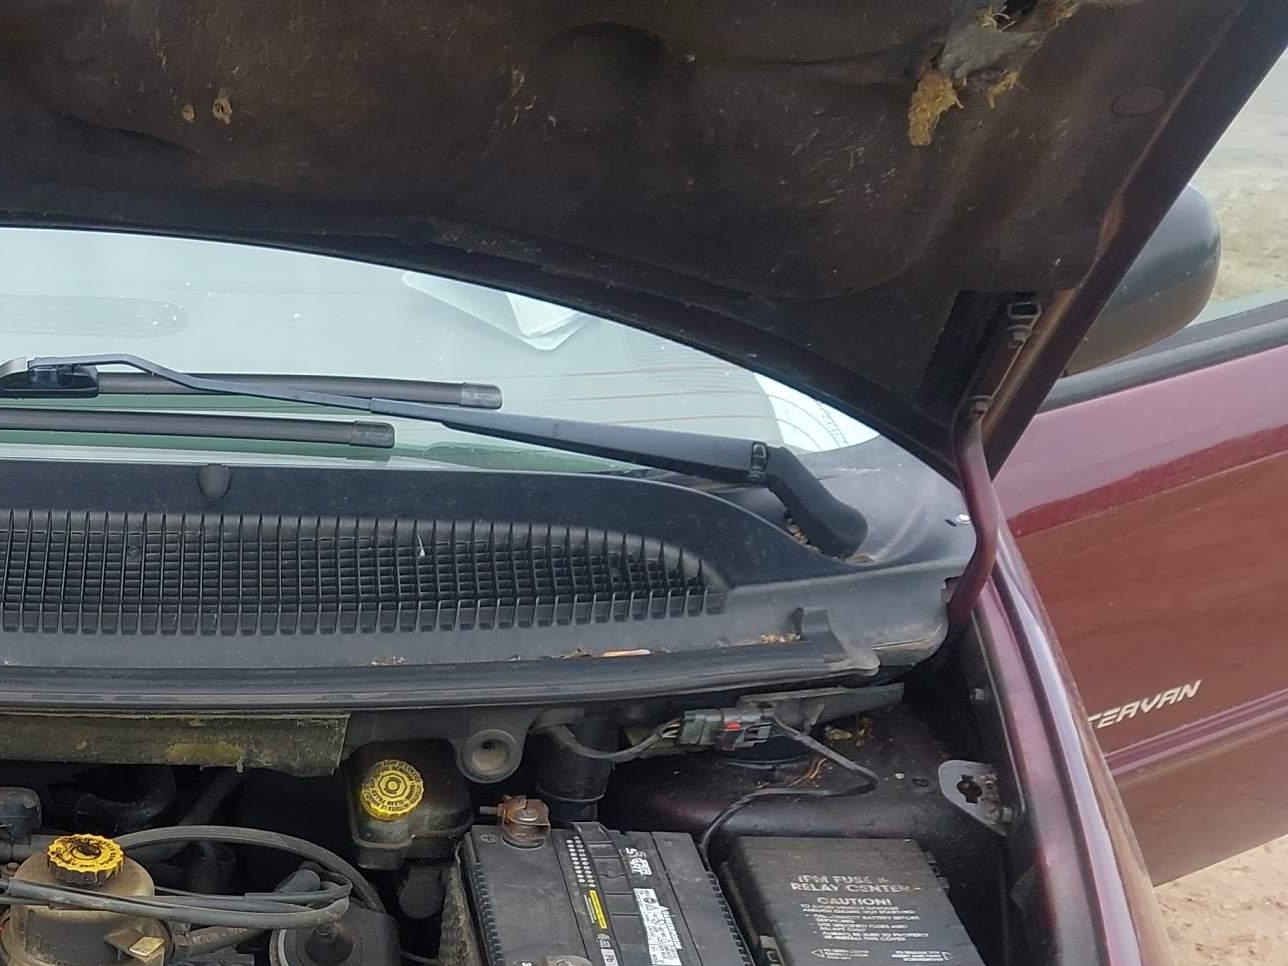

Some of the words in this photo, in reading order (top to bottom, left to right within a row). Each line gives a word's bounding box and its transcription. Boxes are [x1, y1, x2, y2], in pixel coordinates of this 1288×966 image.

[790, 883, 839, 892] RELAY
[846, 884, 911, 893] CENTER
[817, 897, 892, 906] CAUTION!
